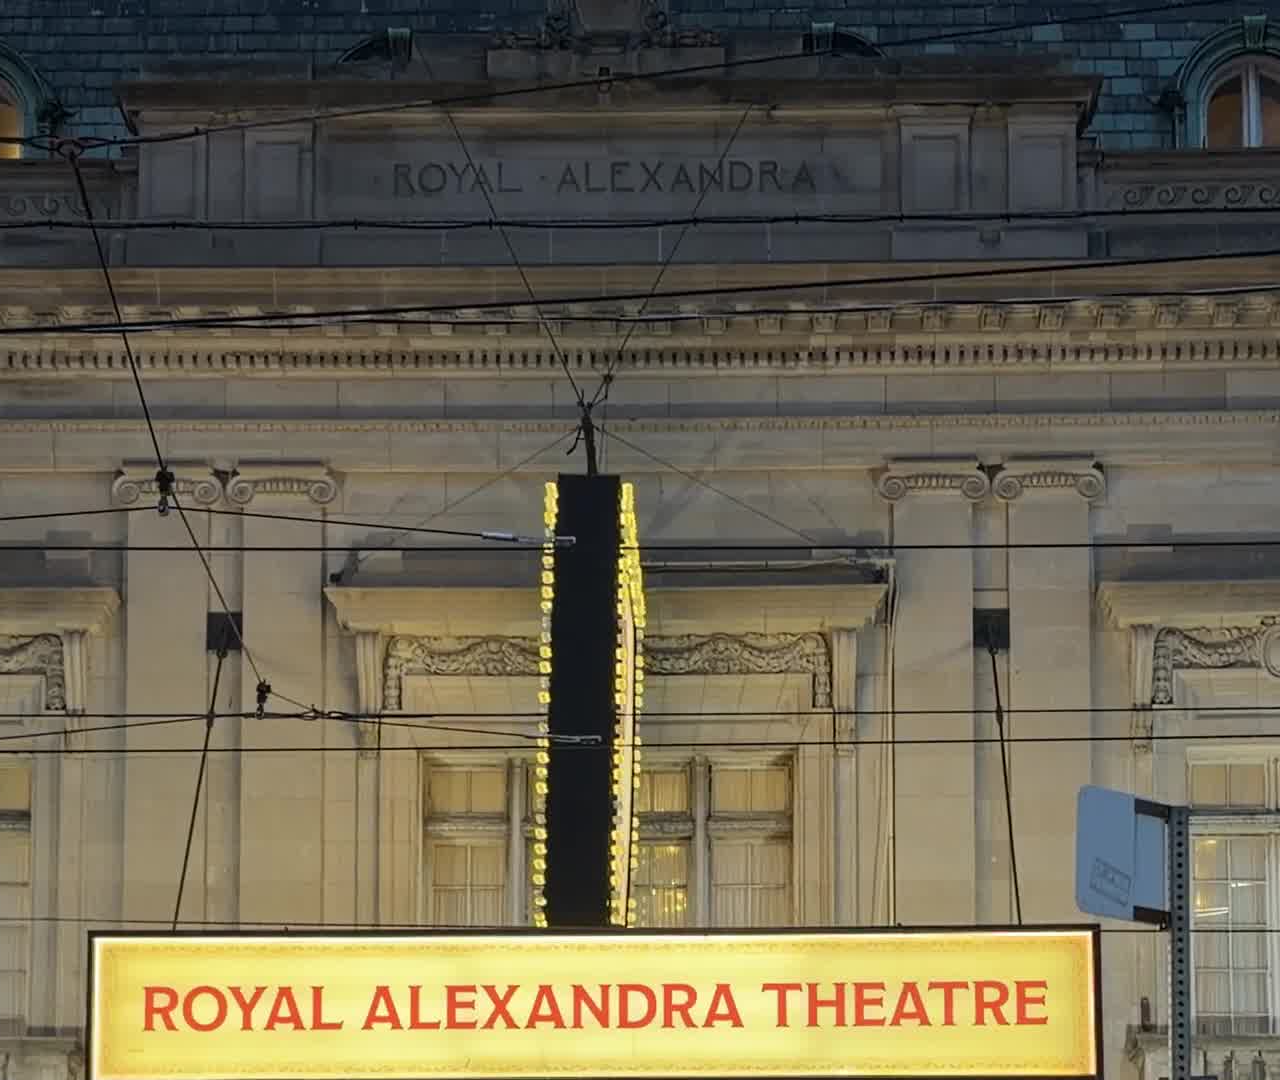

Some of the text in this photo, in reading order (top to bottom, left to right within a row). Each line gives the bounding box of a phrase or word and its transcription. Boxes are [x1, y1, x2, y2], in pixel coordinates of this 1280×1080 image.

[393, 159, 818, 196] ROYAL ALEXANDRA
[142, 979, 1050, 1033] ROYAL ALEXANDRA THEATRE
